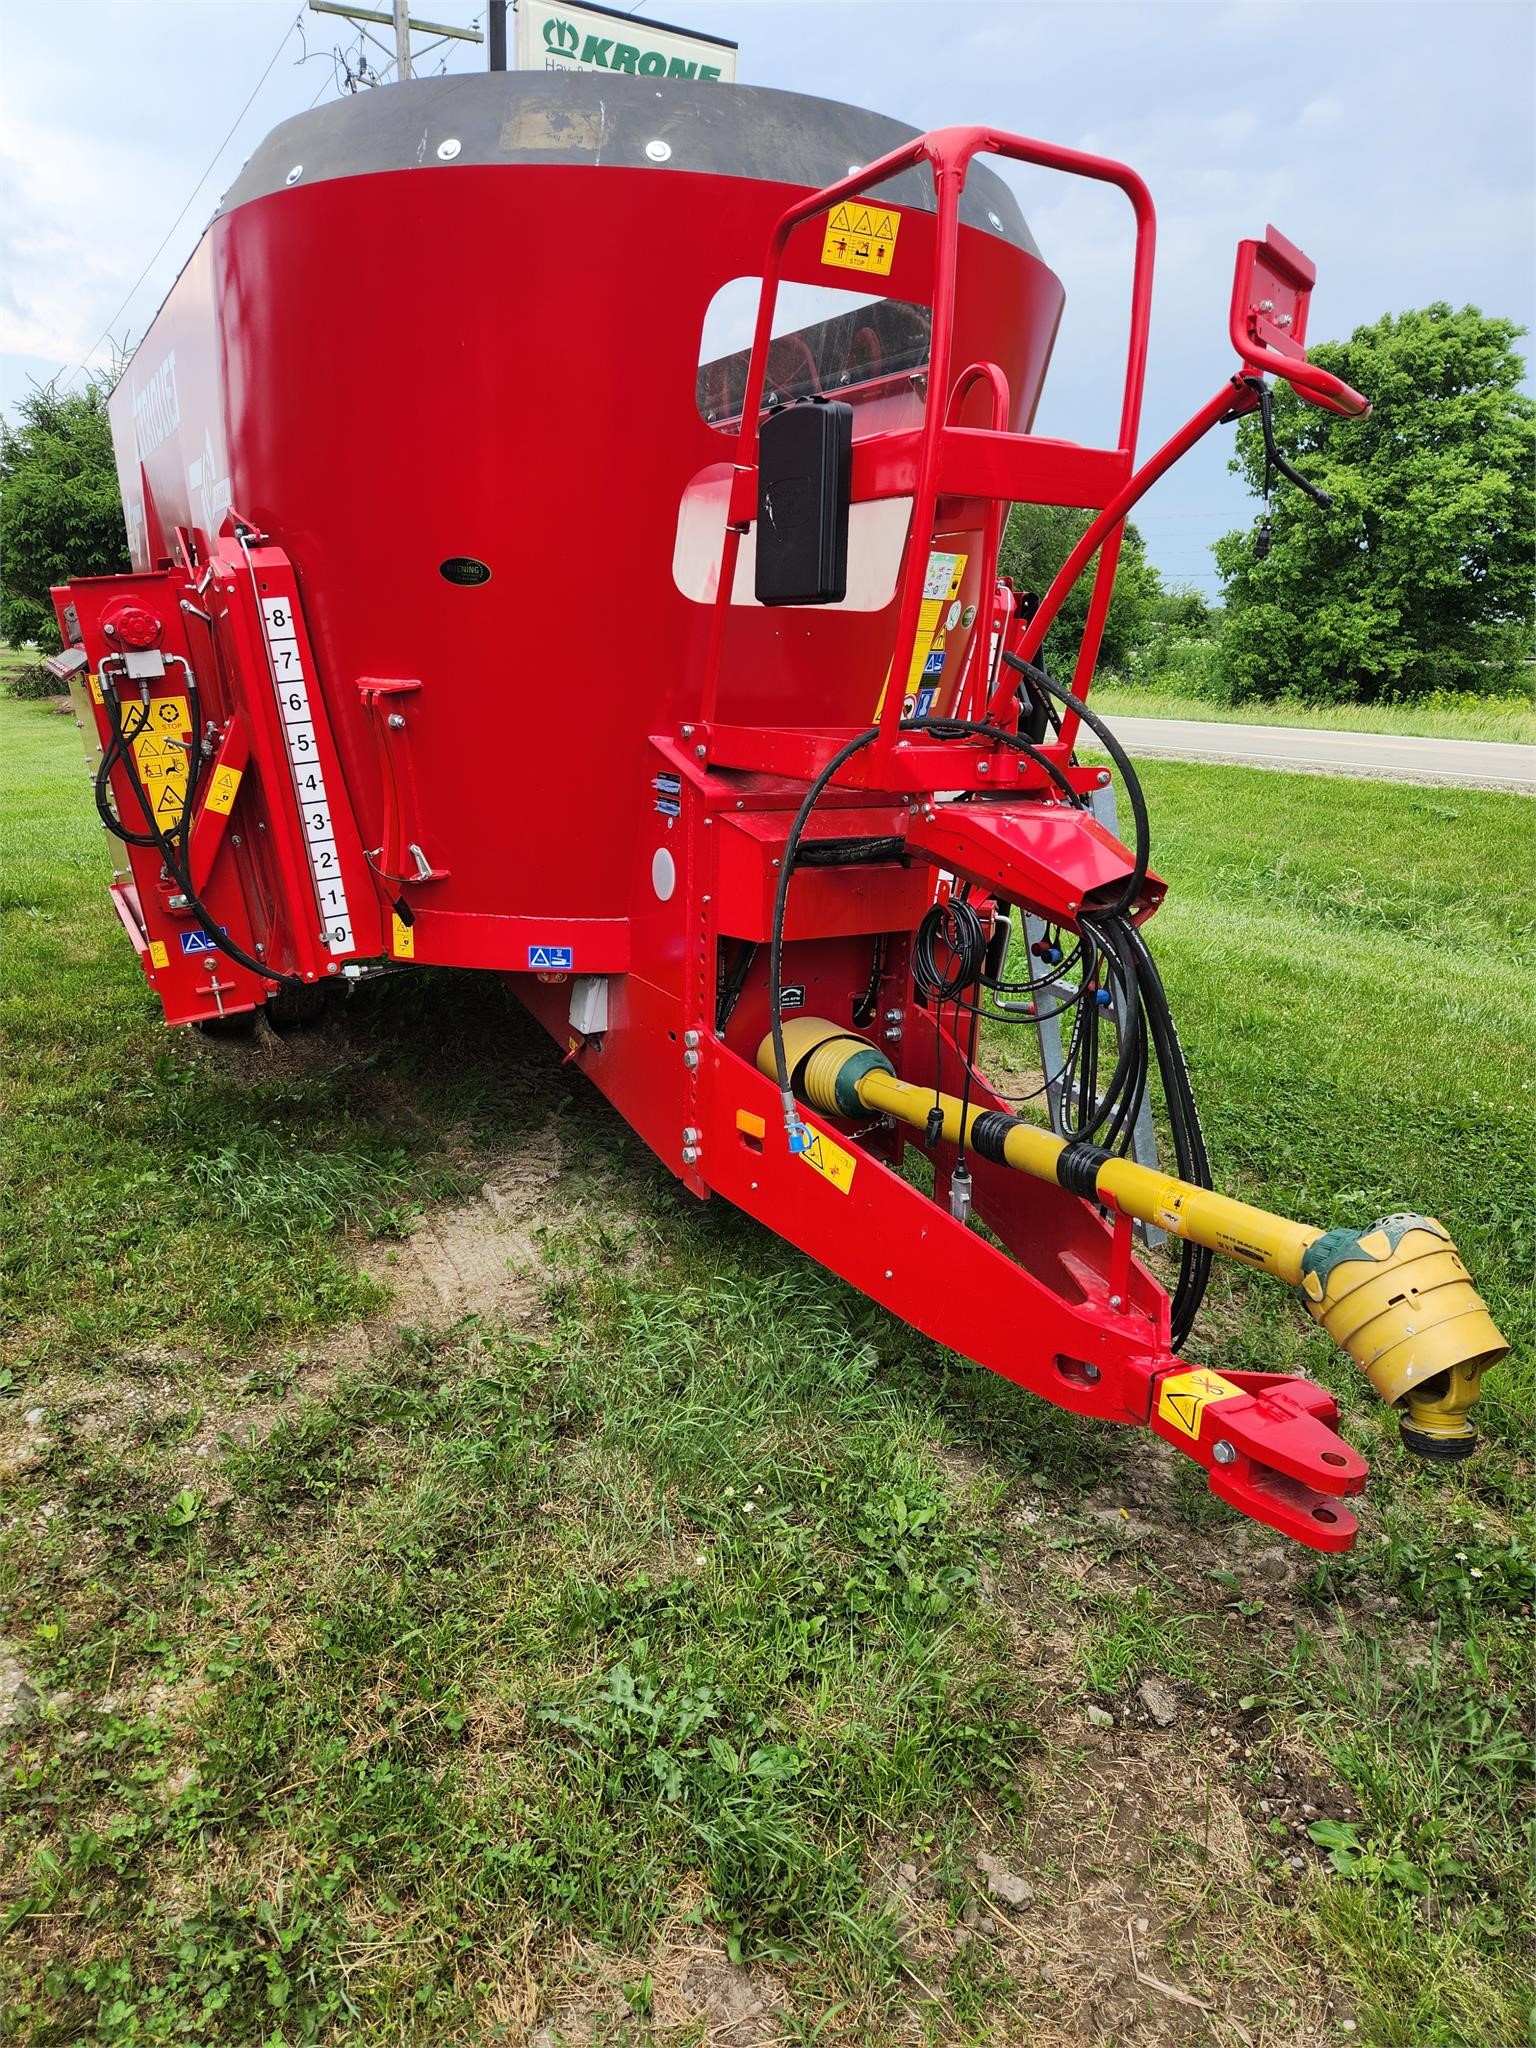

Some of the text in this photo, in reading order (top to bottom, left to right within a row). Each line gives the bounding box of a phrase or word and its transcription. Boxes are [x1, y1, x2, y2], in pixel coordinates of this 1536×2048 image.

[580, 35, 721, 82] KRONE
[273, 609, 285, 627] 8
[280, 652, 291, 669] 7
[289, 693, 302, 710] 6
[161, 722, 183, 730] STOP
[297, 734, 309, 751] 5
[305, 775, 317, 791] 4
[312, 814, 324, 831] 3
[320, 852, 332, 868] 2
[328, 889, 336, 905] 1
[335, 926, 346, 942] 0
